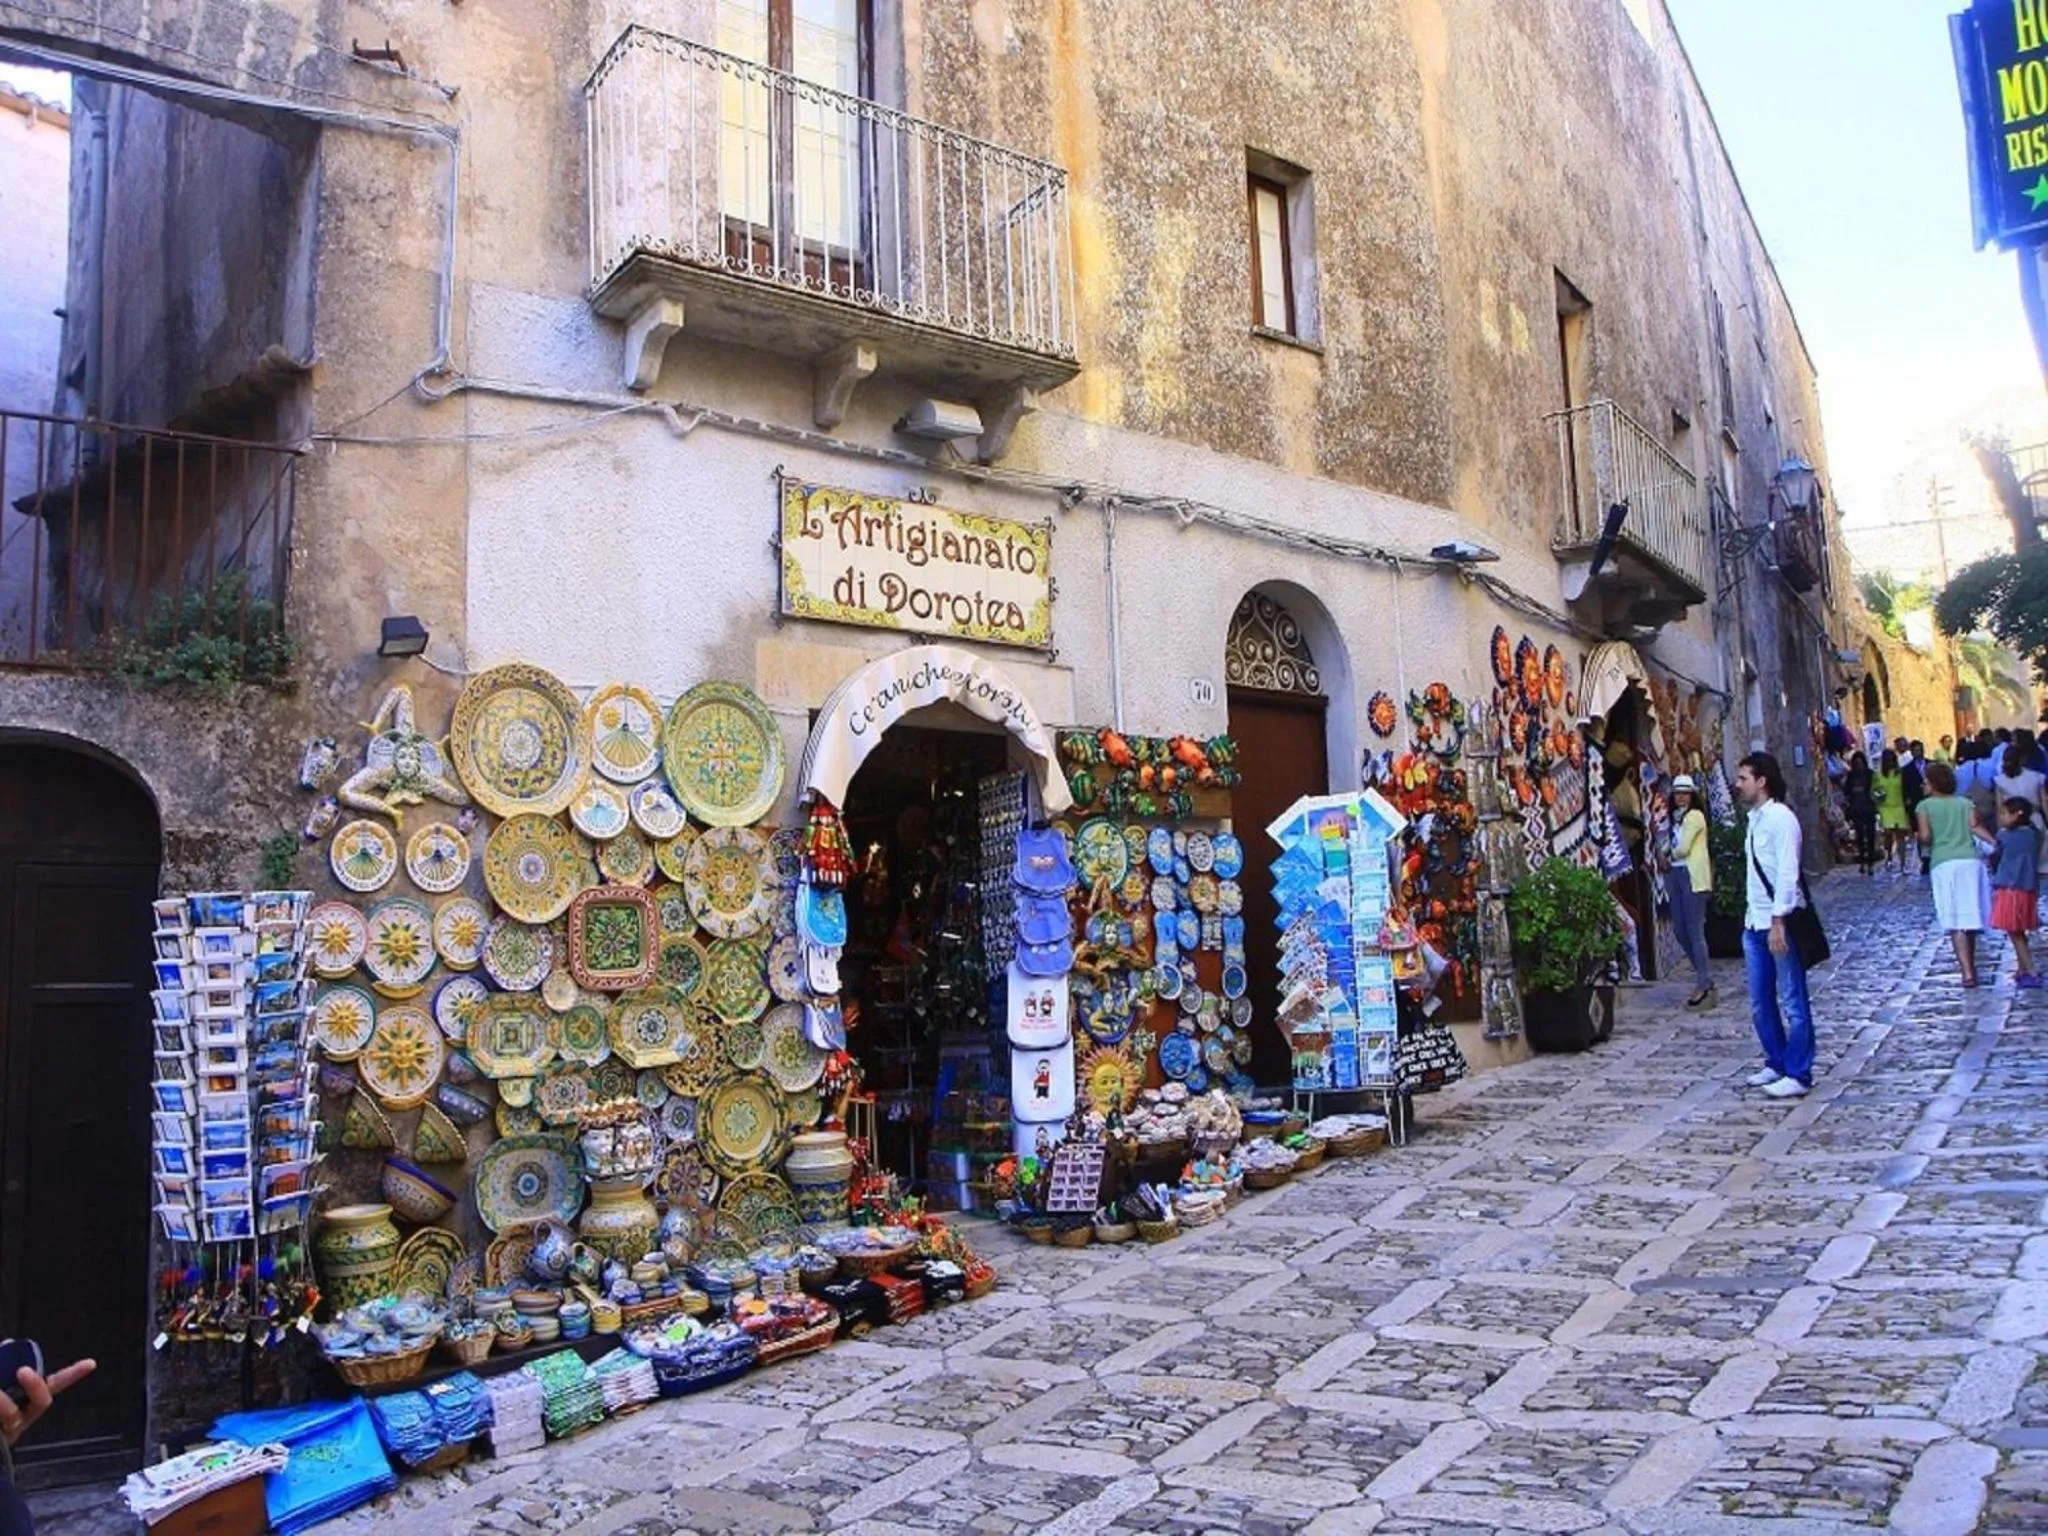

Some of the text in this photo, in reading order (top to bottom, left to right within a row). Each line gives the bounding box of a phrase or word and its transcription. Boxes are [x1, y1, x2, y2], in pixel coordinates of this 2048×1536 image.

[1997, 56, 2048, 124] MO
[2004, 124, 2048, 172] RIS
[800, 491, 1036, 575] L'Artigianato
[833, 565, 1025, 632] di Dorotea
[849, 661, 951, 736] Ceramiche
